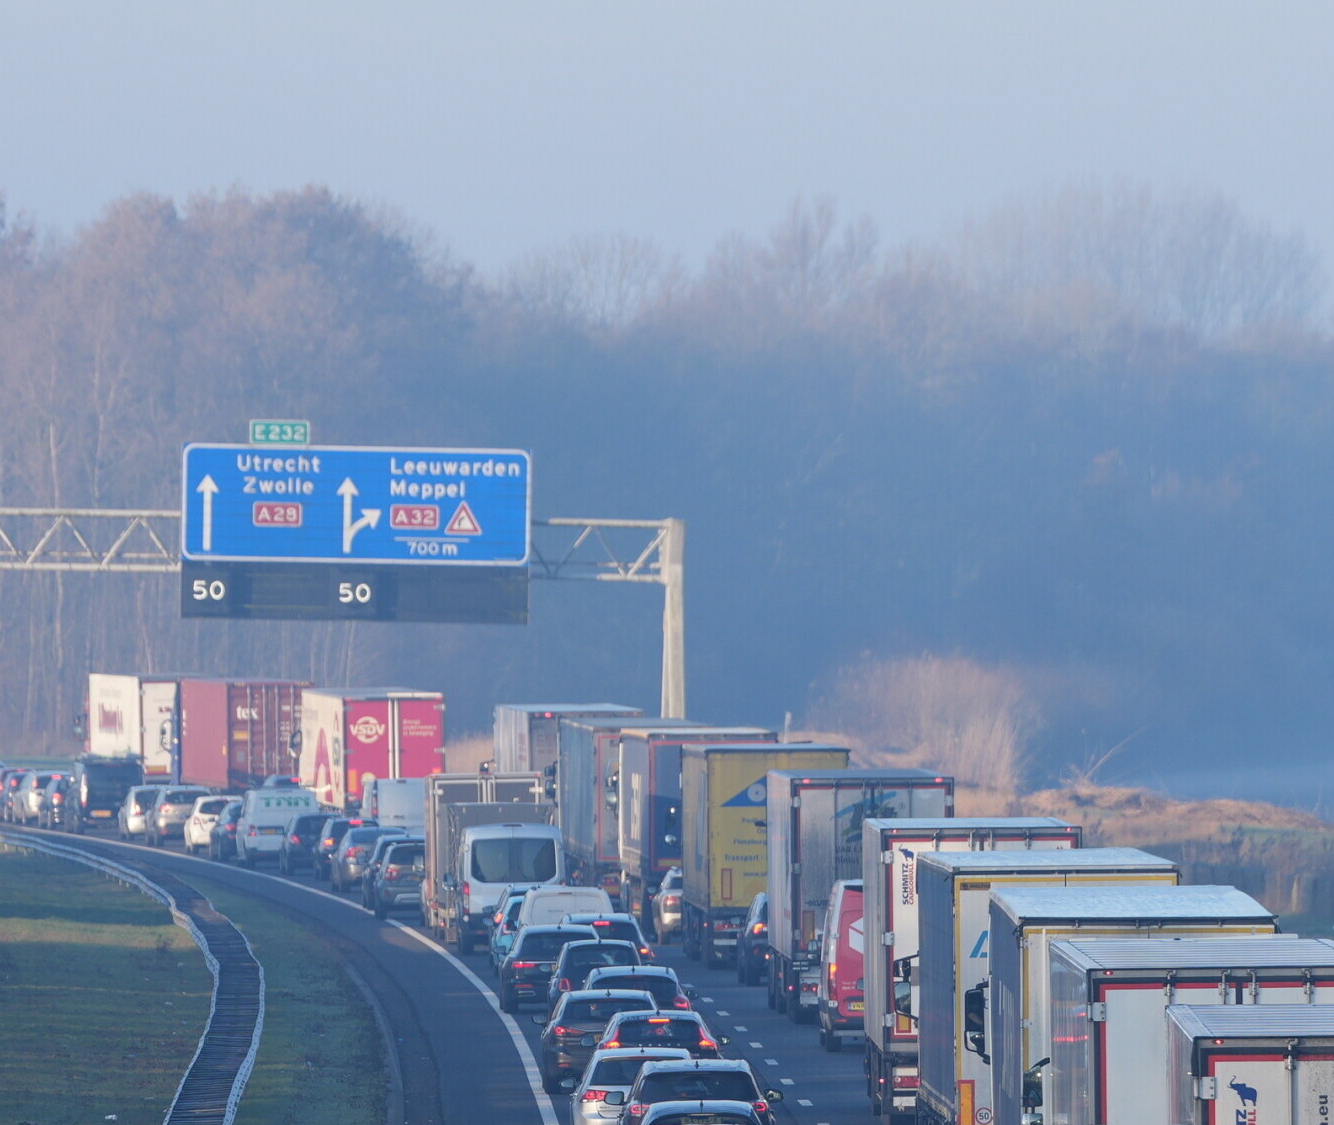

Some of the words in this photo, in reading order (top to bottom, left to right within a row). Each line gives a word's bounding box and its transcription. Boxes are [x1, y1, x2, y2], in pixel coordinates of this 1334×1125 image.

[237, 454, 320, 473] Utrecht
[390, 457, 520, 477] Leeuwarden
[243, 476, 314, 494] Zwolle
[390, 479, 465, 499] Meppel
[408, 541, 439, 556] 700
[442, 543, 458, 556] m
[193, 580, 225, 600] 50
[339, 582, 371, 603] 50
[236, 705, 258, 720] tex
[349, 723, 386, 735] VSDV
[978, 1112, 990, 1120] 50
